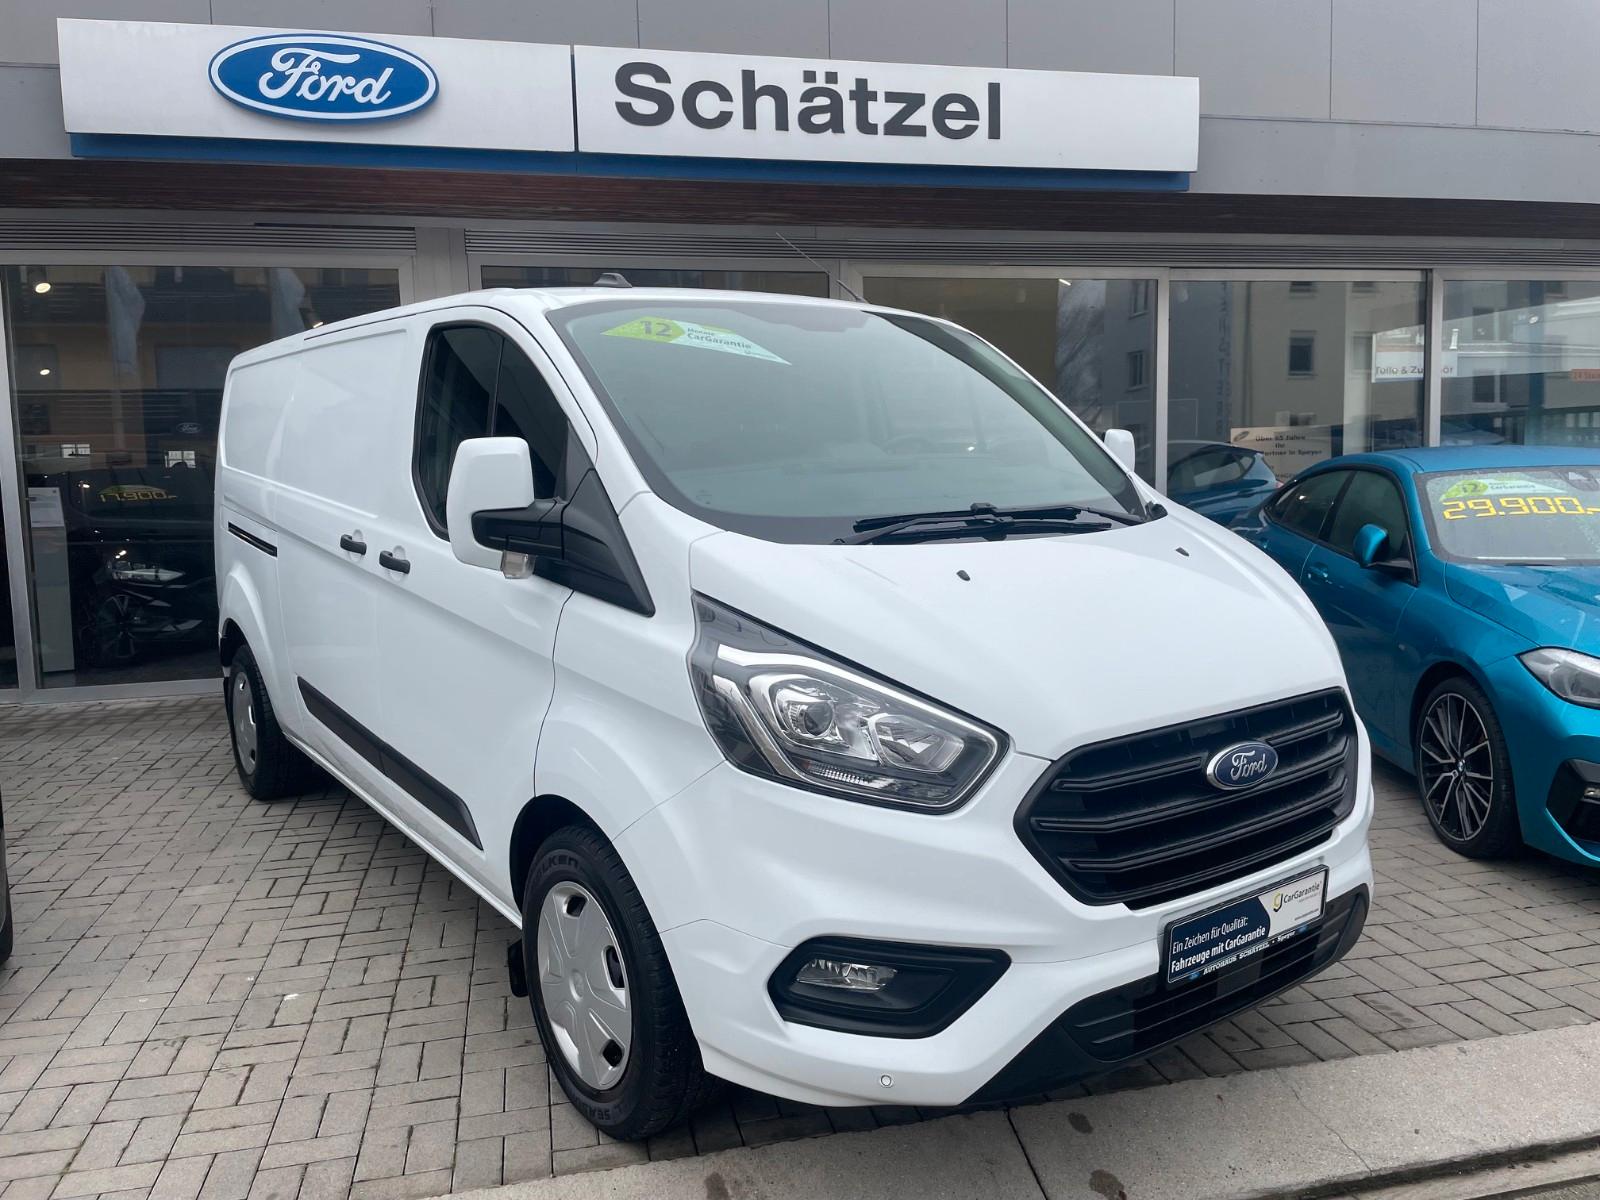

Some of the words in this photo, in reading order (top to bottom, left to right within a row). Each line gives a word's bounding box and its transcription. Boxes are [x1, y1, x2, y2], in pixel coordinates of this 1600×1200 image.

[258, 47, 395, 105] Ford
[614, 61, 1001, 140] Schätzel
[640, 320, 673, 337] 12
[687, 333, 753, 350] CarGarantie
[1230, 750, 1268, 781] Ford
[1283, 882, 1320, 904] CarGarantie
[1171, 950, 1210, 973] Fahrzeuge
[1211, 942, 1224, 957] mit
[1225, 926, 1266, 953] CarGarantie
[1172, 941, 1183, 955] Ein
[1184, 933, 1210, 950] Zeichen
[1210, 926, 1220, 941] für
[1221, 916, 1249, 936] Qualität:
[1203, 954, 1237, 976] AUTOHAUS
